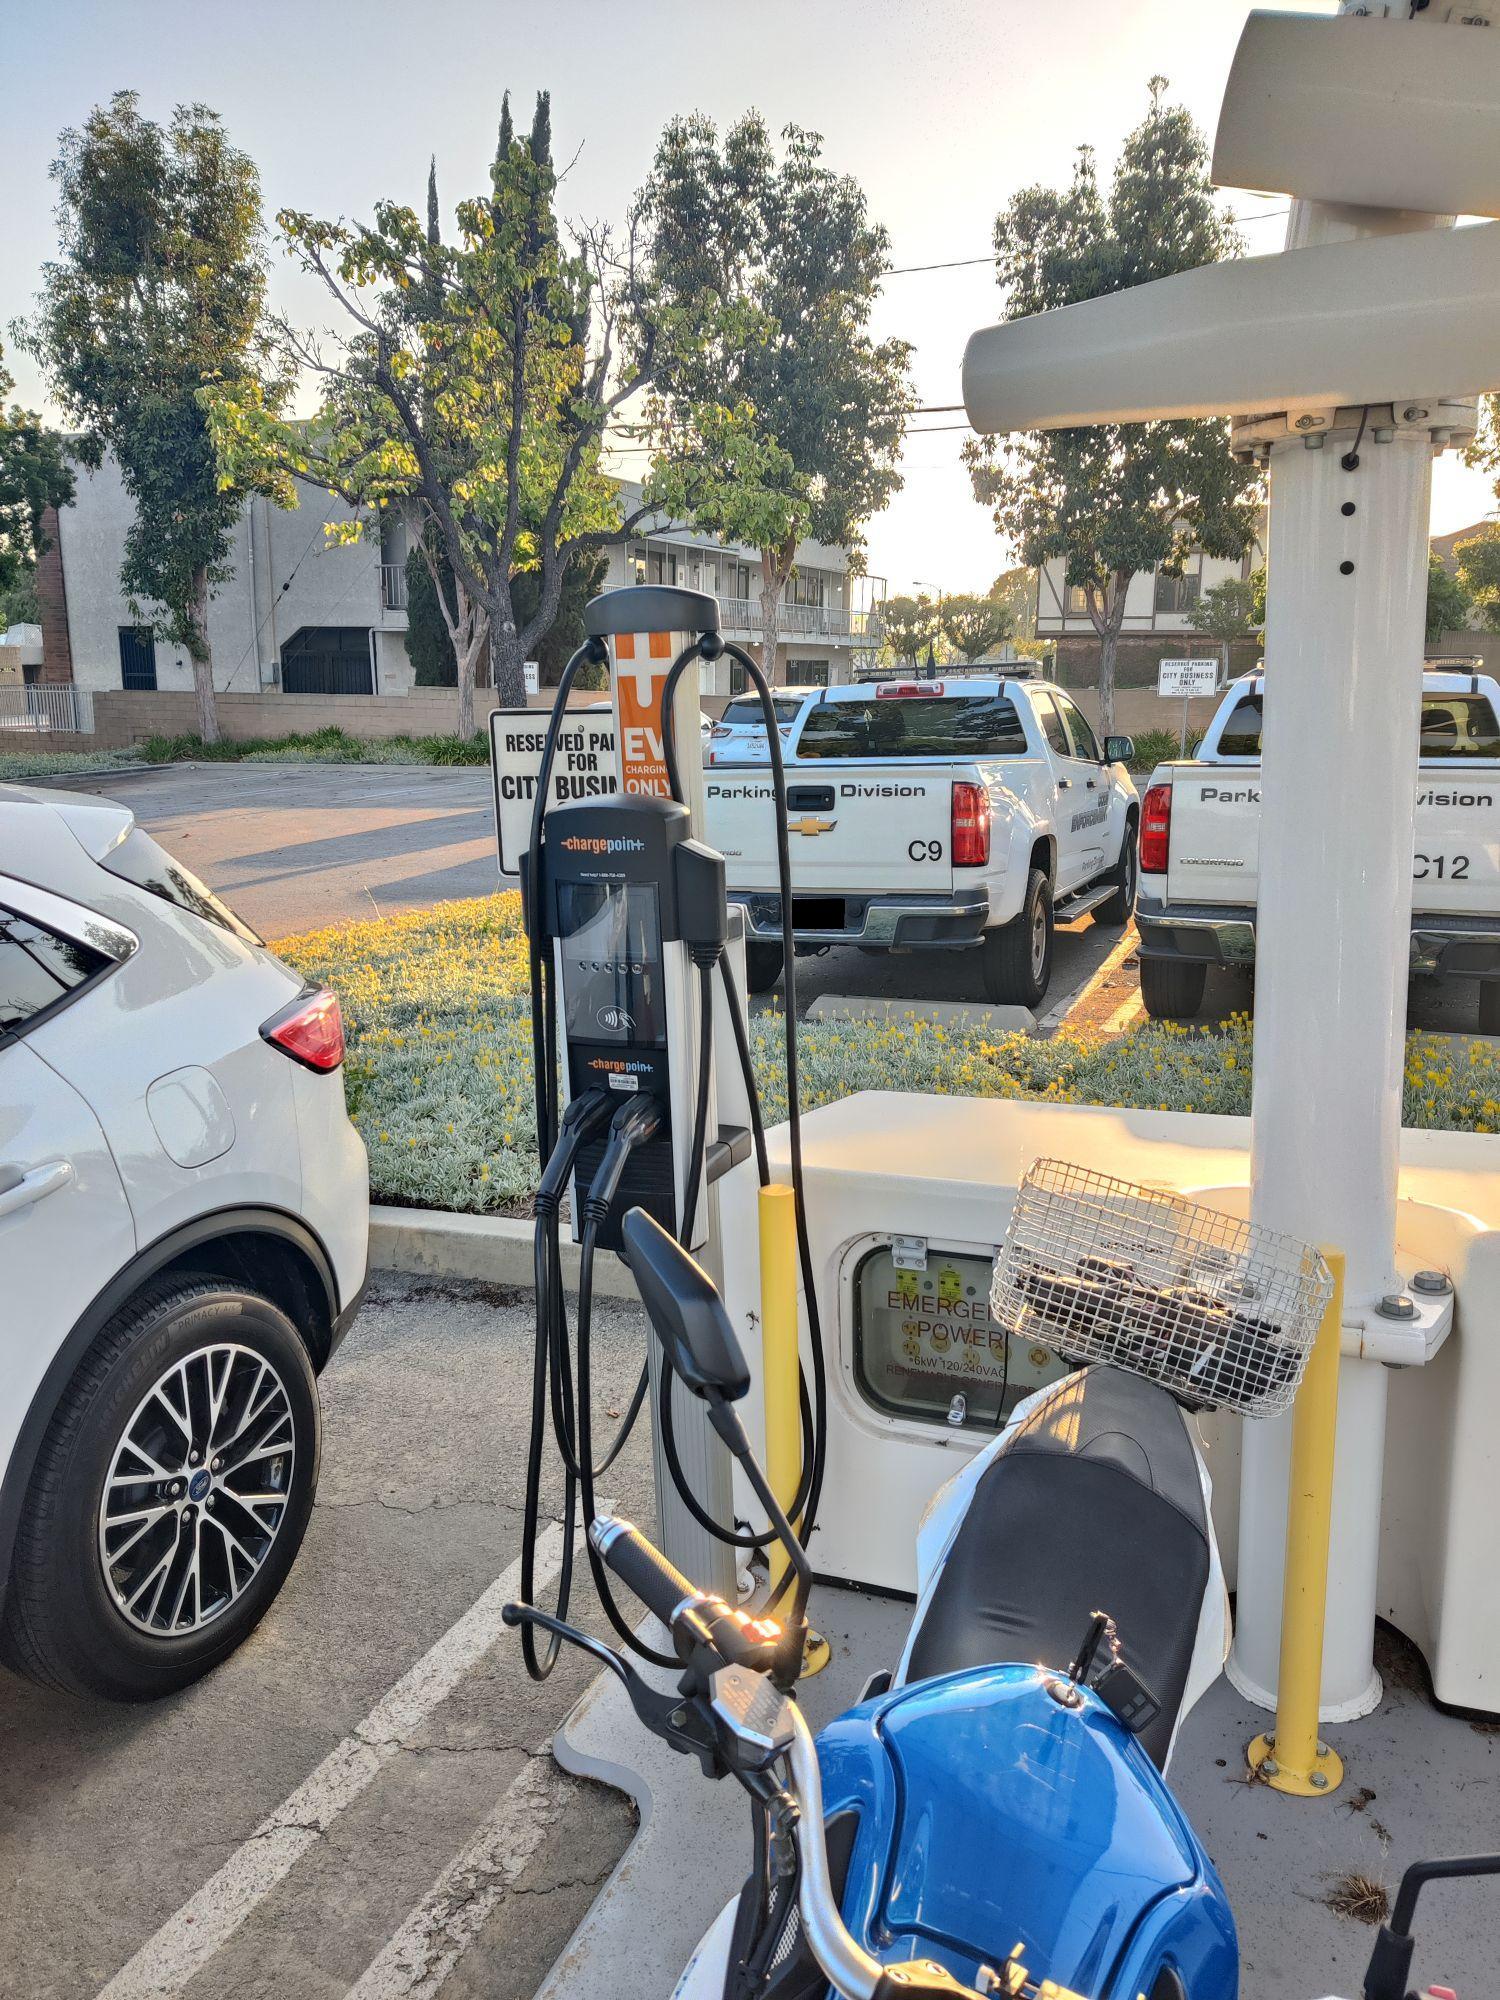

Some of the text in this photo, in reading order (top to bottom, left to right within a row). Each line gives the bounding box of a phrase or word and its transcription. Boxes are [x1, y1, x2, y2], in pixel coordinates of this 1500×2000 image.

[505, 733, 584, 752] RESEVED
[623, 727, 665, 761] EV
[567, 753, 598, 771] FOR
[625, 765, 668, 774] CHARGIN
[555, 775, 618, 800] BUSIN
[626, 778, 673, 797] ONLY
[840, 784, 926, 797] Division
[1200, 788, 1493, 807] Park vision
[908, 840, 943, 862] C9
[1180, 857, 1244, 867] COLORADO
[1413, 854, 1470, 880] C12
[887, 1290, 992, 1322] EMERGE
[178, 1306, 220, 1330] PRIMACY
[917, 1320, 1004, 1350] POWER
[914, 1355, 938, 1368] 6kW
